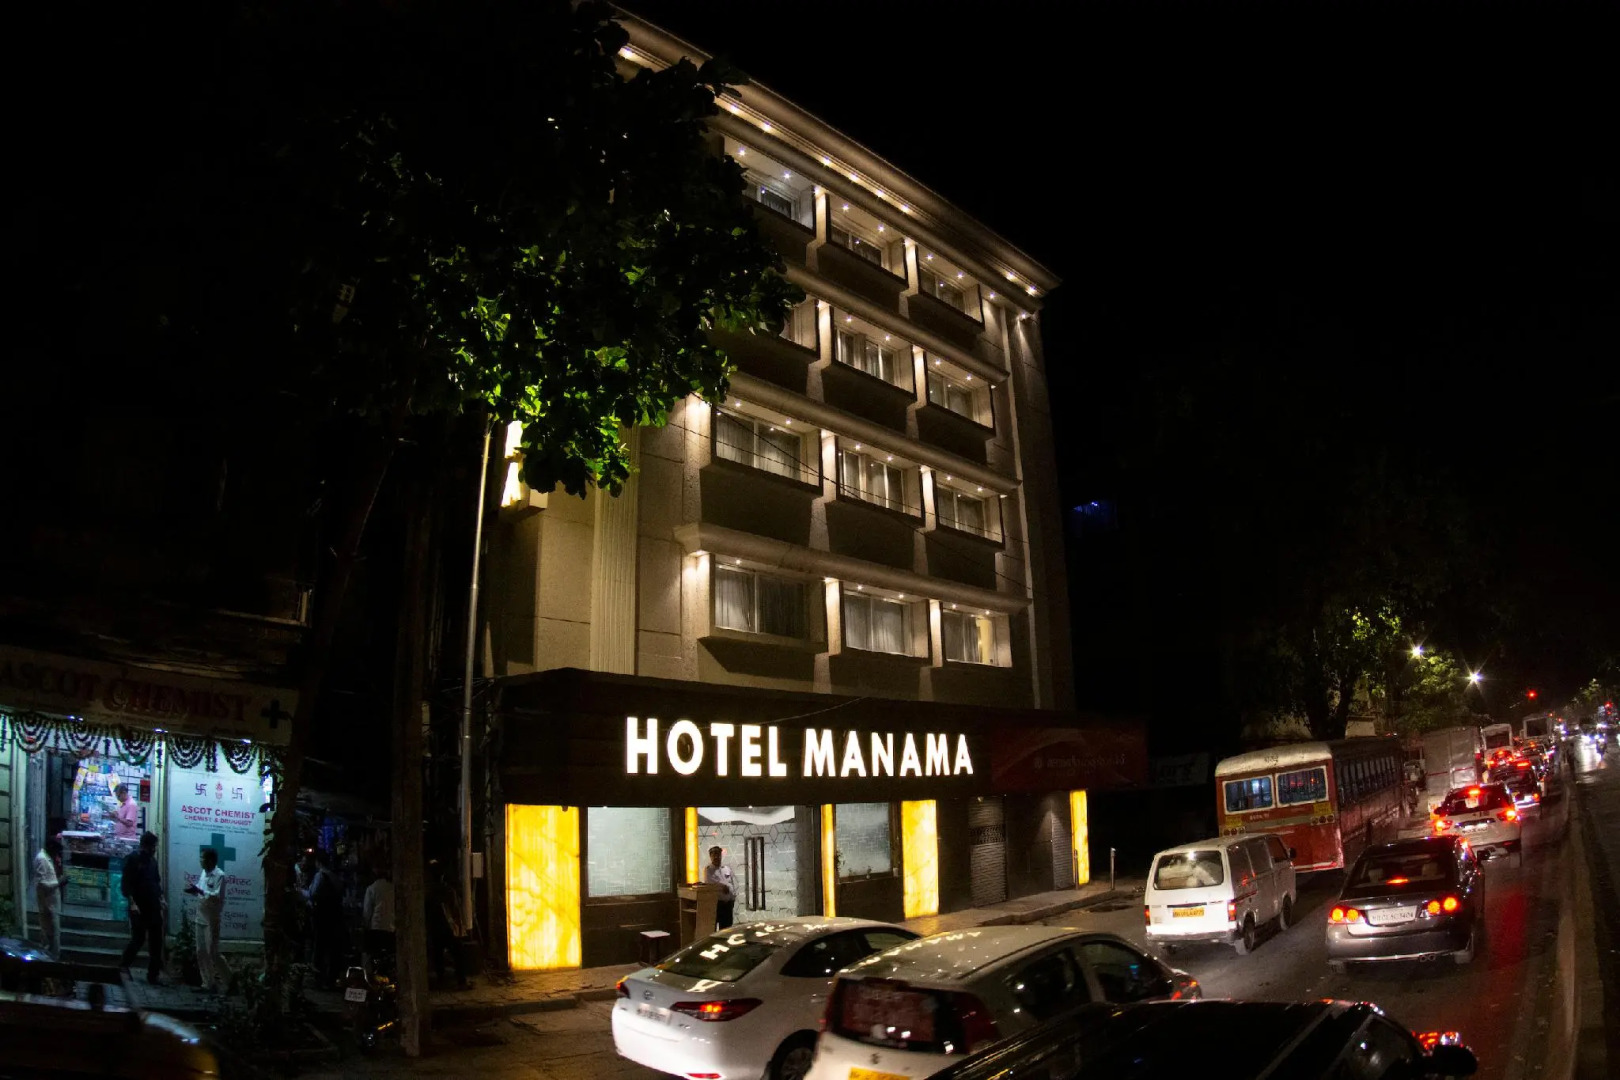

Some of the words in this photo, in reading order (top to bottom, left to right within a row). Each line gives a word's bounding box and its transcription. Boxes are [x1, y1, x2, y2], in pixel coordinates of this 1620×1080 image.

[104, 678, 252, 720] CHEMIST
[626, 716, 787, 777] HOTEL
[803, 728, 974, 777] MANAMA
[182, 805, 212, 815] ASCOT
[215, 808, 255, 818] CHEMIST
